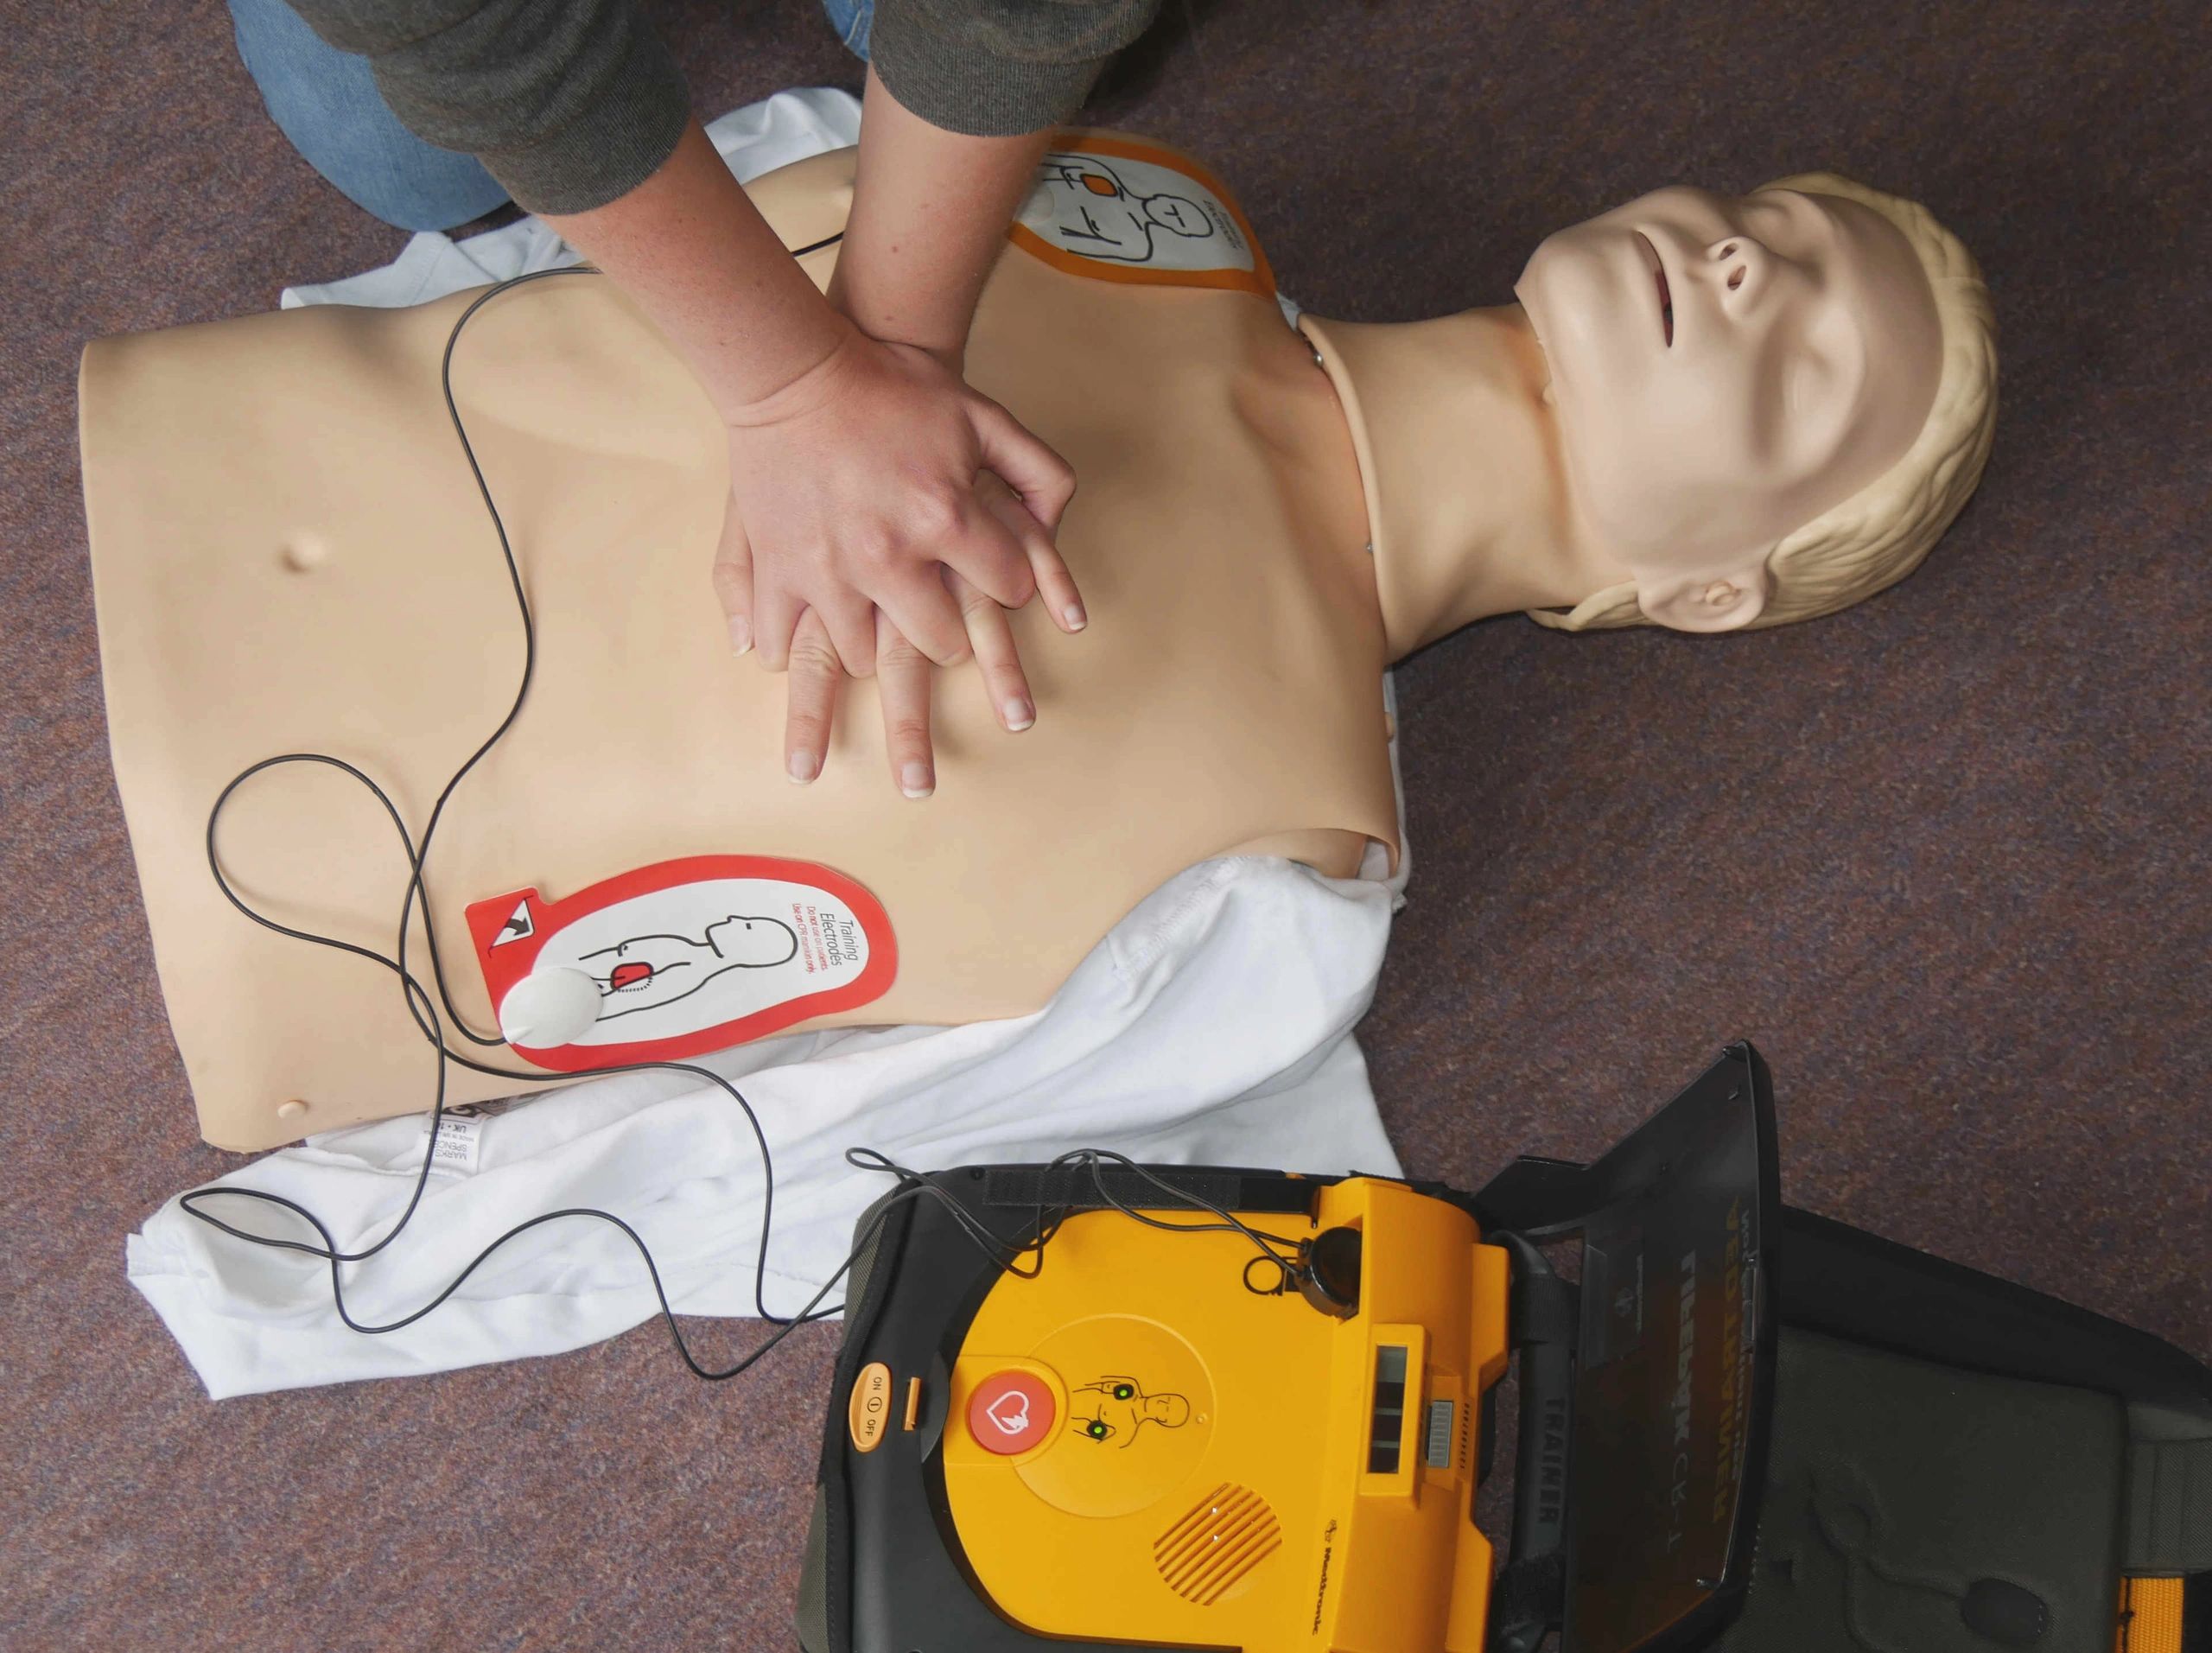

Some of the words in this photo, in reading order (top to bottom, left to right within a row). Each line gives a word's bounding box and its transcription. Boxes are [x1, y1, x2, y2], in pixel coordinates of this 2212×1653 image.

[807, 906, 817, 915] Do
[792, 903, 803, 914] Use
[798, 923, 809, 936] CPR
[809, 916, 819, 926] not
[812, 927, 821, 938] use
[819, 913, 843, 966] Electrodes
[814, 938, 823, 946] on
[839, 920, 859, 961] Training
[434, 1141, 467, 1152] SPENCE
[435, 1149, 467, 1160] MARKS
[873, 1376, 882, 1390] ON
[865, 1419, 877, 1437] OFF
[1540, 1397, 1566, 1522] TRAINER
[1313, 1548, 1332, 1636] Medtronic
